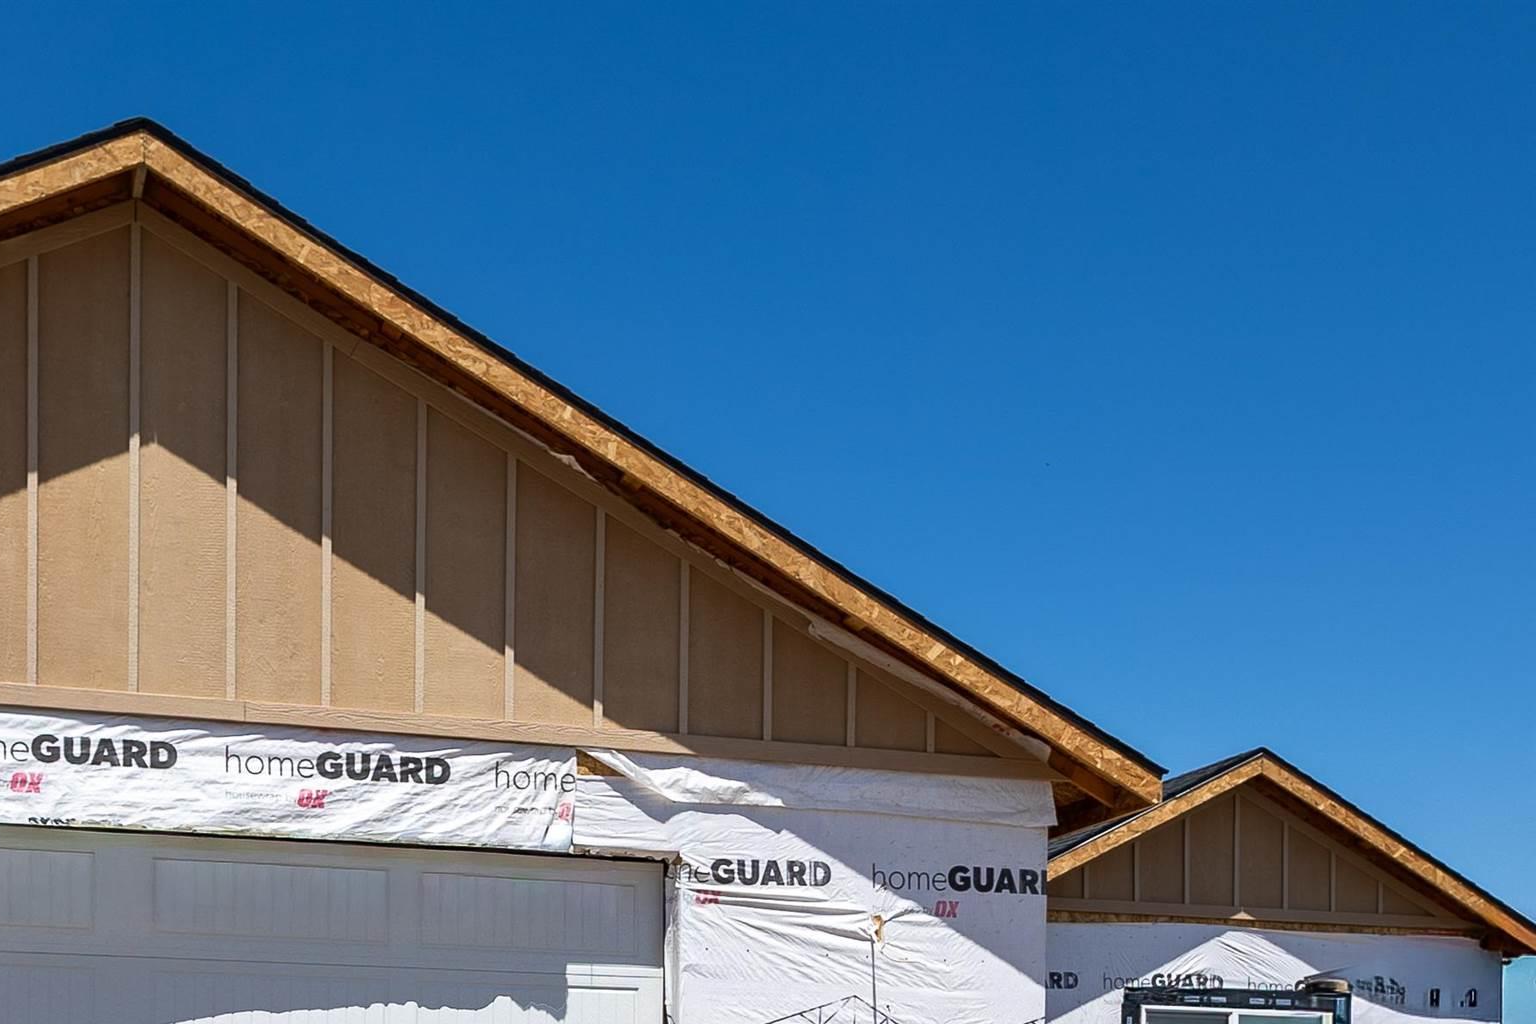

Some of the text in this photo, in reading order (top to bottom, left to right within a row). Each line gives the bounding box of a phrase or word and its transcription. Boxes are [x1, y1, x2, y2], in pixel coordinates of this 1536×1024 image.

[225, 745, 451, 785] homeGUARD
[872, 863, 1047, 896] homeGUAR
[935, 901, 960, 918] OX
[1045, 972, 1079, 990] RD
